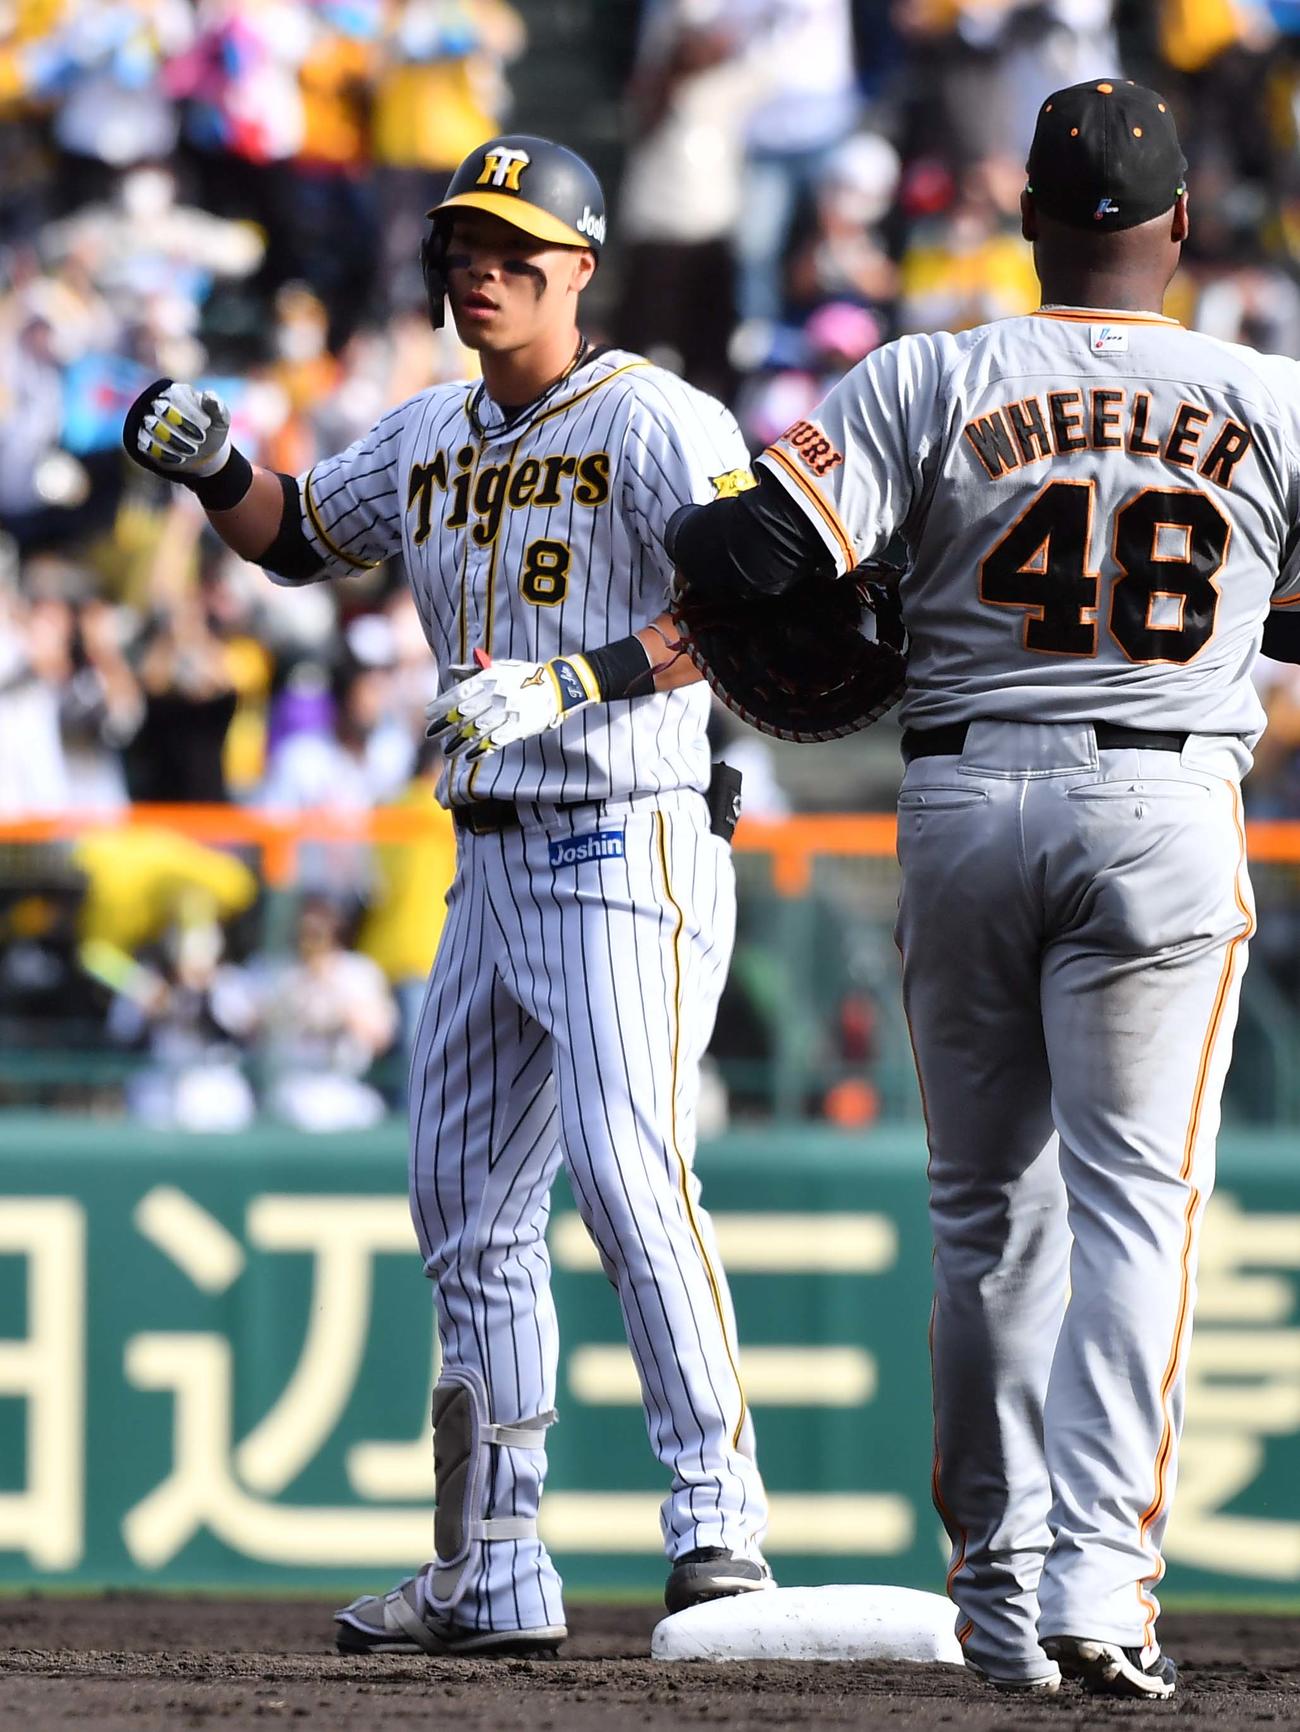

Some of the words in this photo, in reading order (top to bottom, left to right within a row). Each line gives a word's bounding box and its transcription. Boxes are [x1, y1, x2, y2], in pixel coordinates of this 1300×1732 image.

[964, 388, 1253, 489] WHEELER
[407, 449, 610, 548] Tigers
[520, 538, 571, 608] 8
[979, 479, 1233, 665] 48
[550, 833, 623, 867] Joshin
